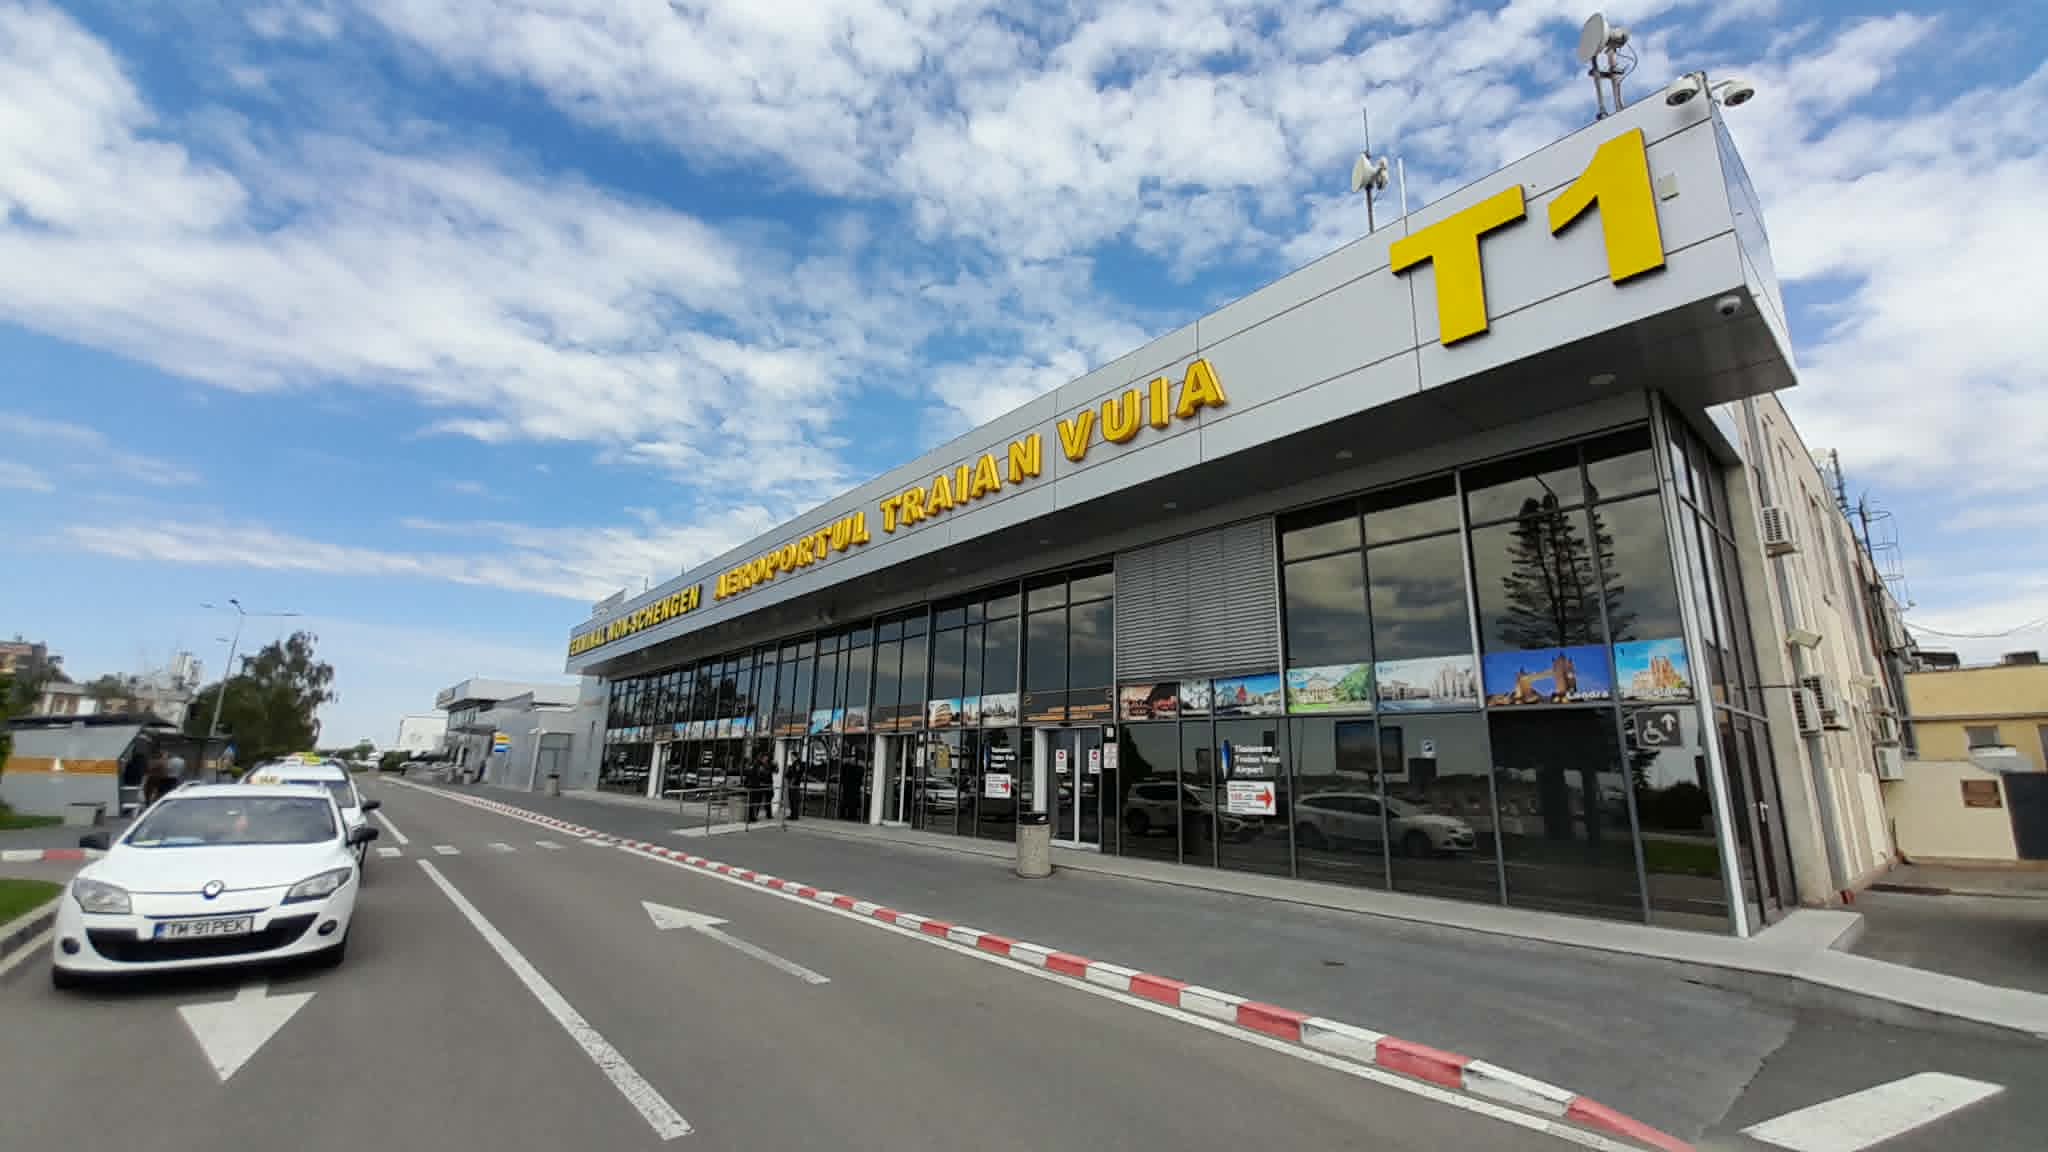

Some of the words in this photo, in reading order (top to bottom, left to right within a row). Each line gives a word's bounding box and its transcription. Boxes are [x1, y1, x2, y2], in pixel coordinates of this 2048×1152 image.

[1389, 127, 1667, 348] T1
[713, 510, 871, 601] AEROPORTUL
[880, 432, 1042, 533] TRAIAN
[1057, 357, 1225, 462] VUIA
